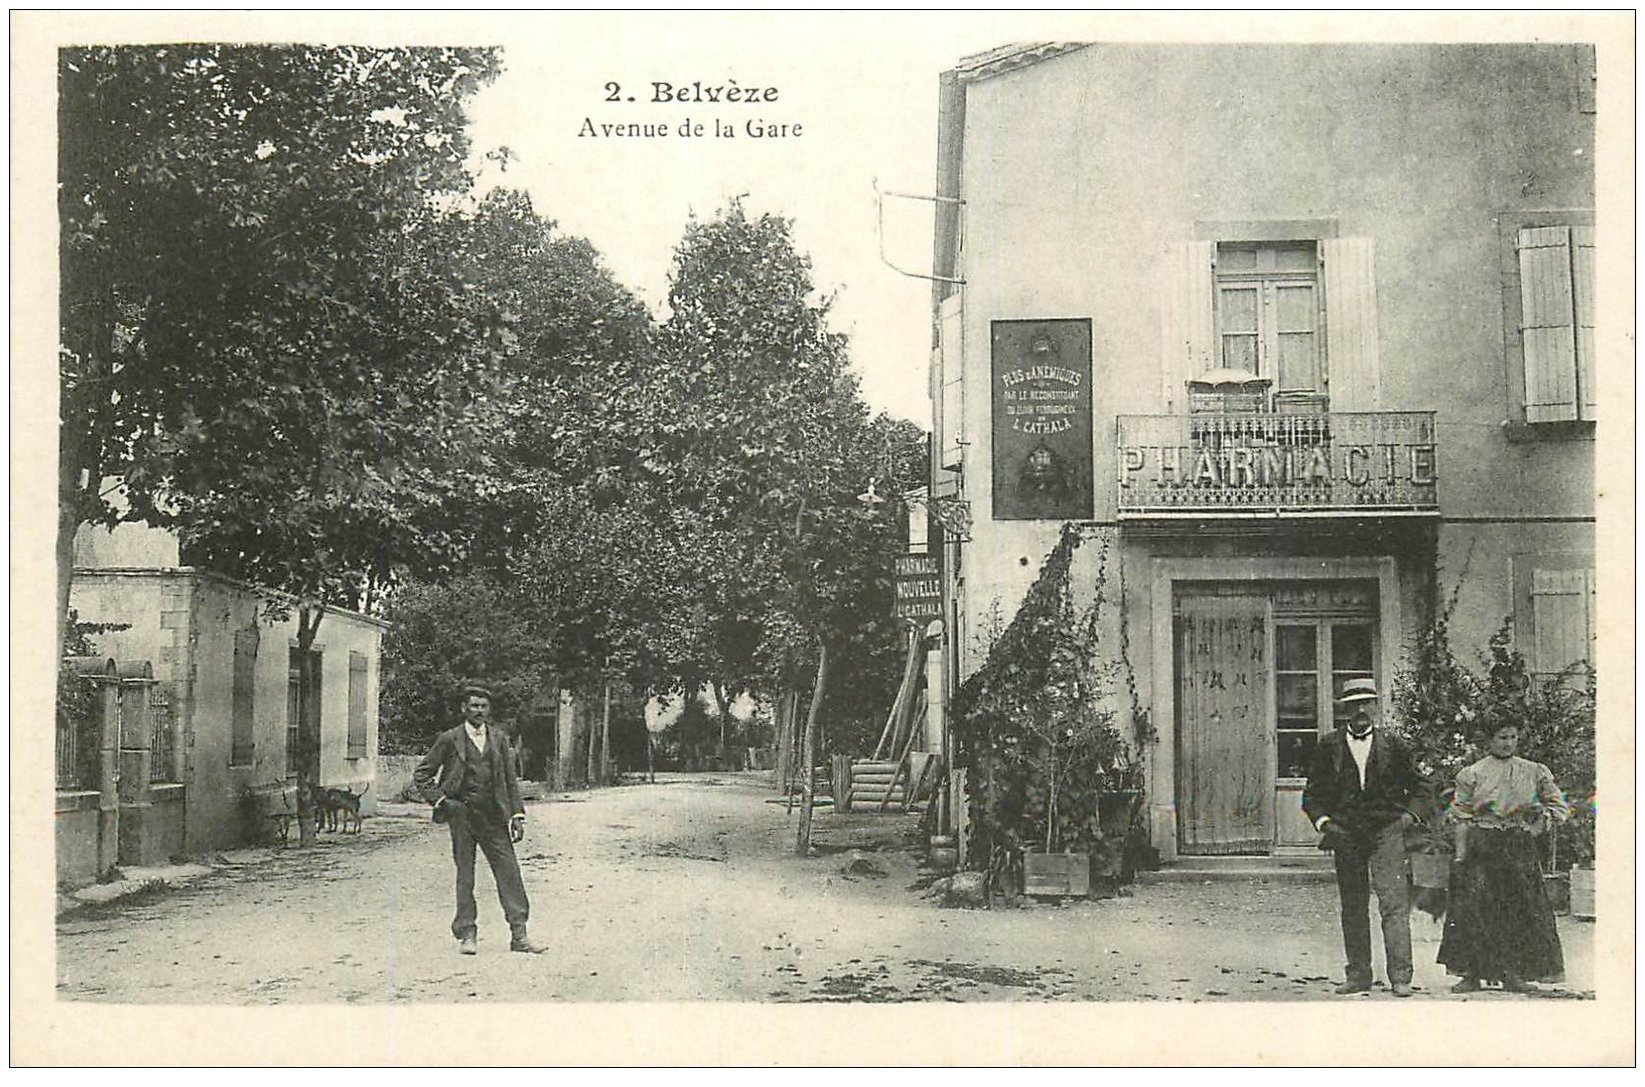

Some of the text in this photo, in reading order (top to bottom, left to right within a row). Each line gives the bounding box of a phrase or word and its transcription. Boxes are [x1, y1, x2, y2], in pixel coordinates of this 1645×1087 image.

[1023, 417, 1072, 434] CATHALA
[1120, 444, 1437, 489] PHARMACIE
[897, 579, 941, 599] NOUVELLE
